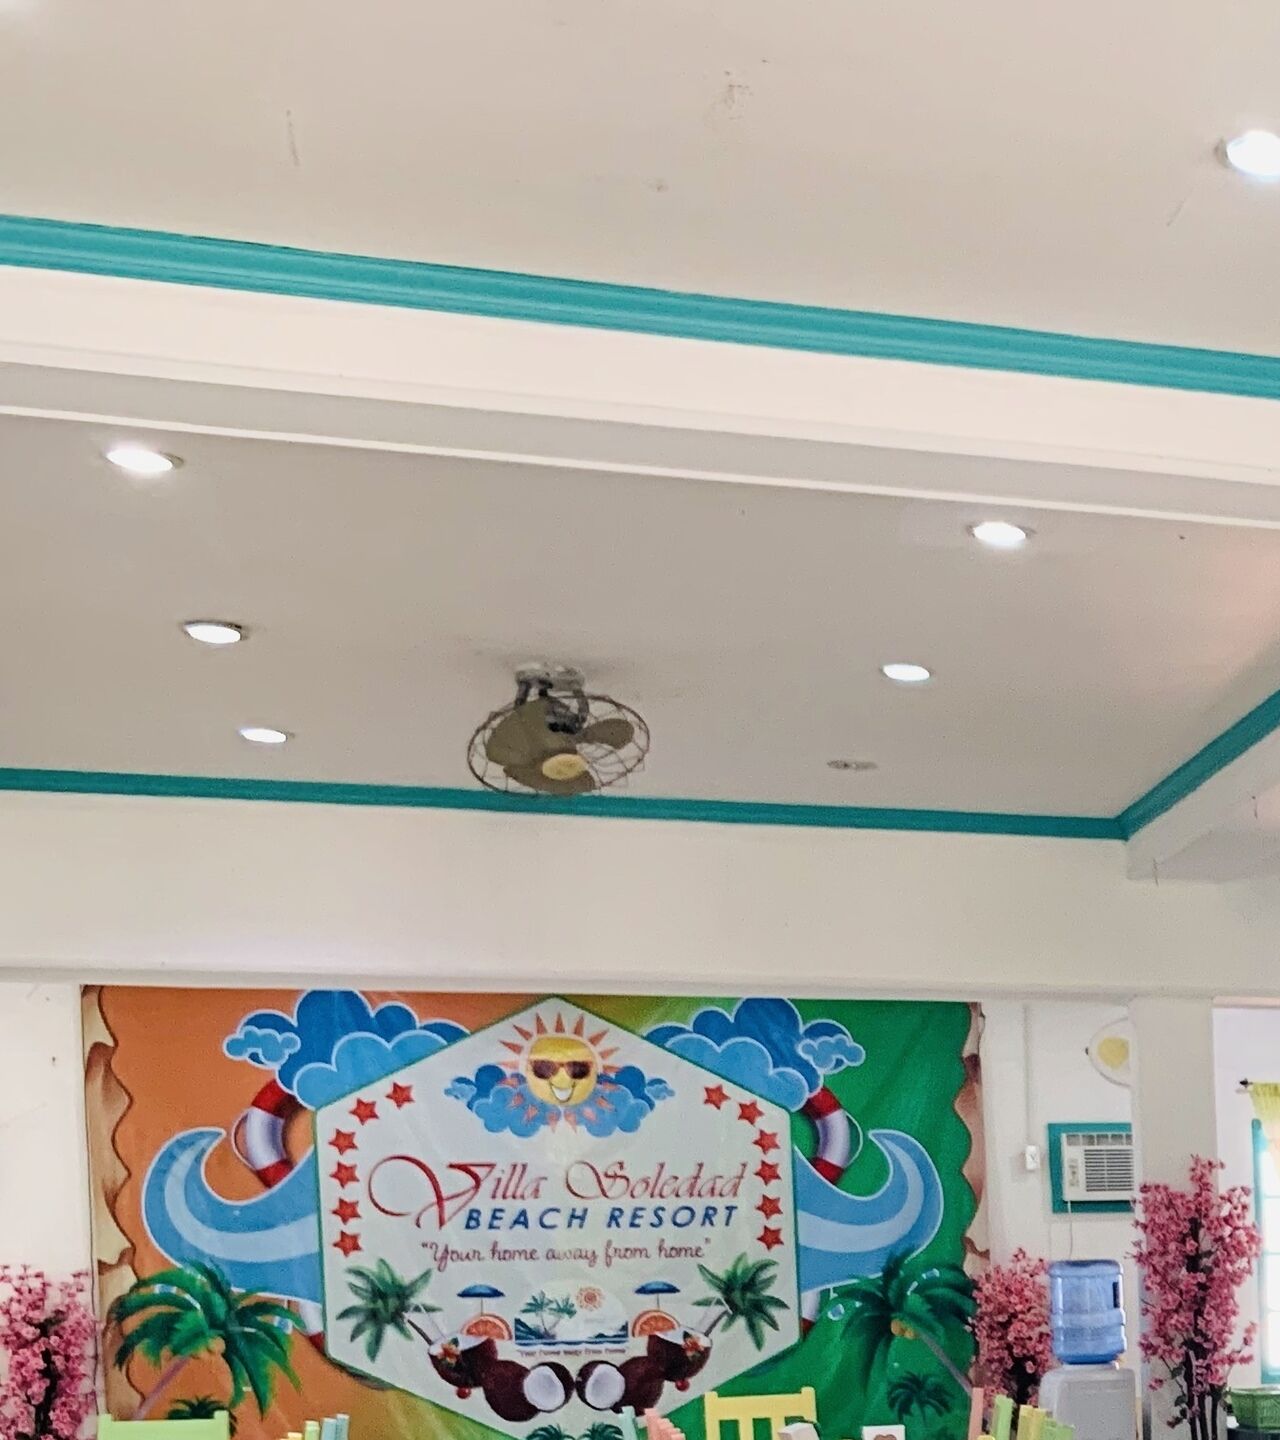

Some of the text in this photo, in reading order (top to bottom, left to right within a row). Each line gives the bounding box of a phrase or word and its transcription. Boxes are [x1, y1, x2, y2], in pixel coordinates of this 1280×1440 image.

[367, 1154, 749, 1230] Villa Soledad
[463, 1204, 739, 1231] BEACH RESORT
[489, 1242, 538, 1262] home
[545, 1246, 597, 1267] away
[604, 1240, 651, 1267] from
